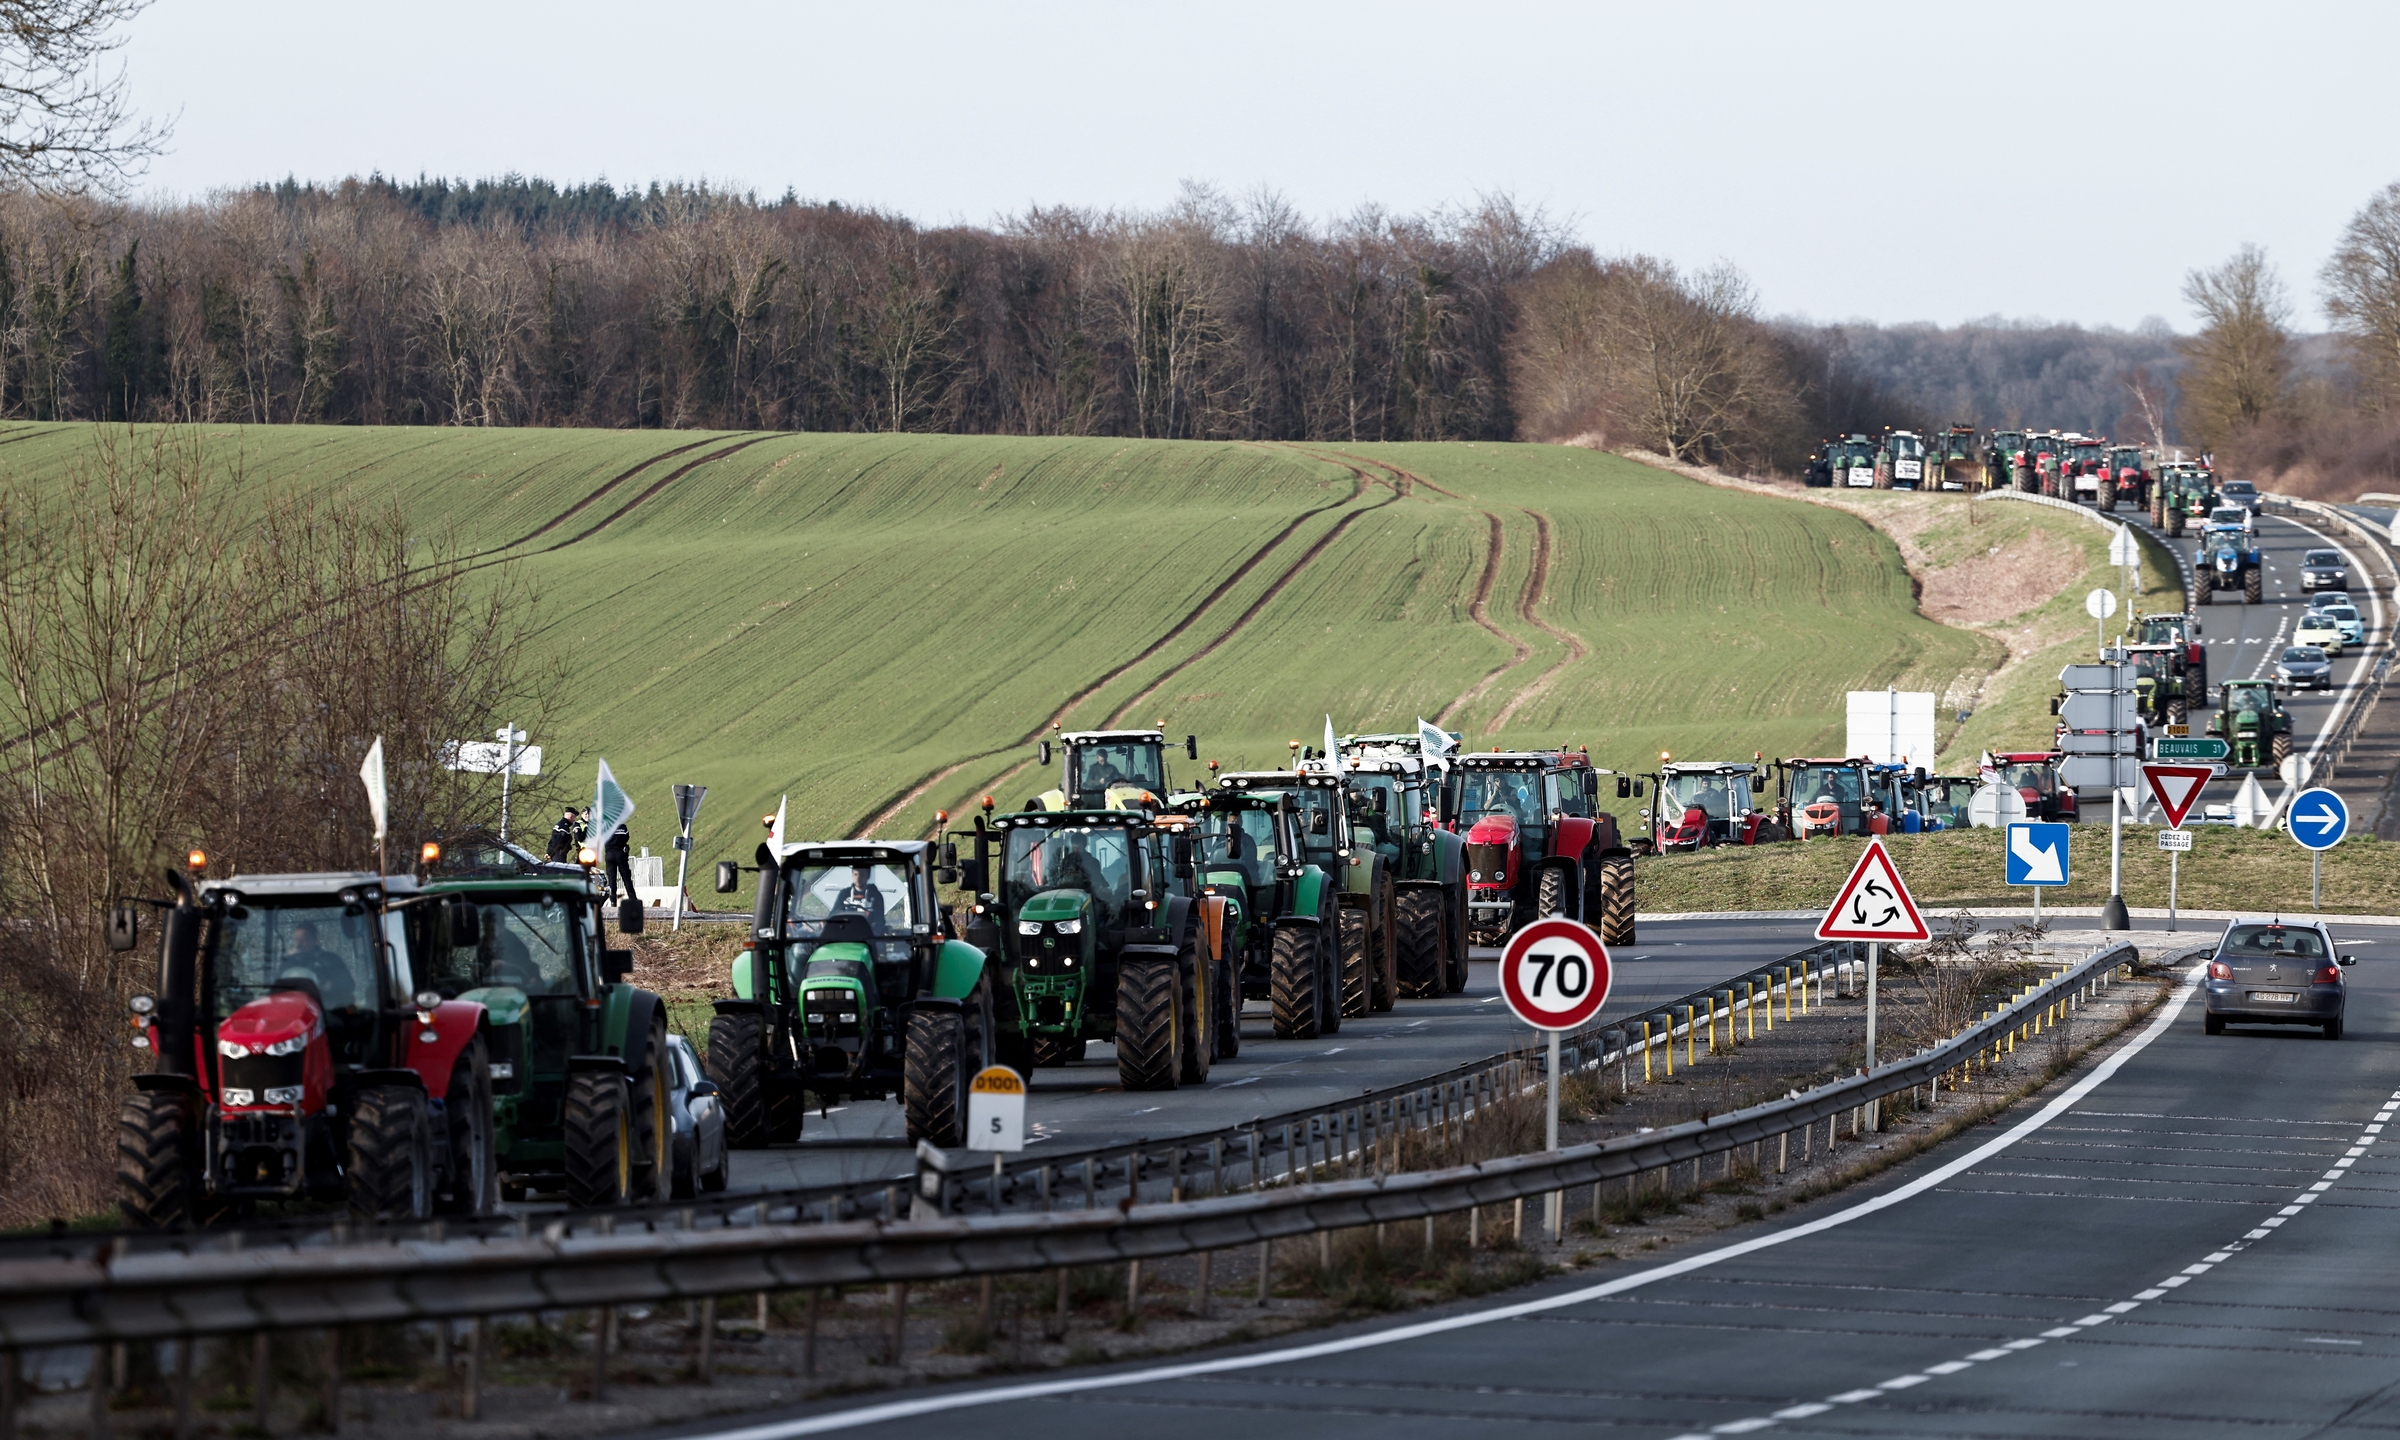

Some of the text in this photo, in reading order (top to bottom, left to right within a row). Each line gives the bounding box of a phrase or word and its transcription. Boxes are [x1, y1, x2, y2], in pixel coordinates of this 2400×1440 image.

[2168, 725, 2189, 734] D1001
[2160, 744, 2222, 754] BEAUVAIS 31
[2217, 766, 2224, 774] 11
[1528, 954, 1587, 998] 70
[976, 1076, 1020, 1090] D1001
[991, 1117, 1002, 1134] 5
